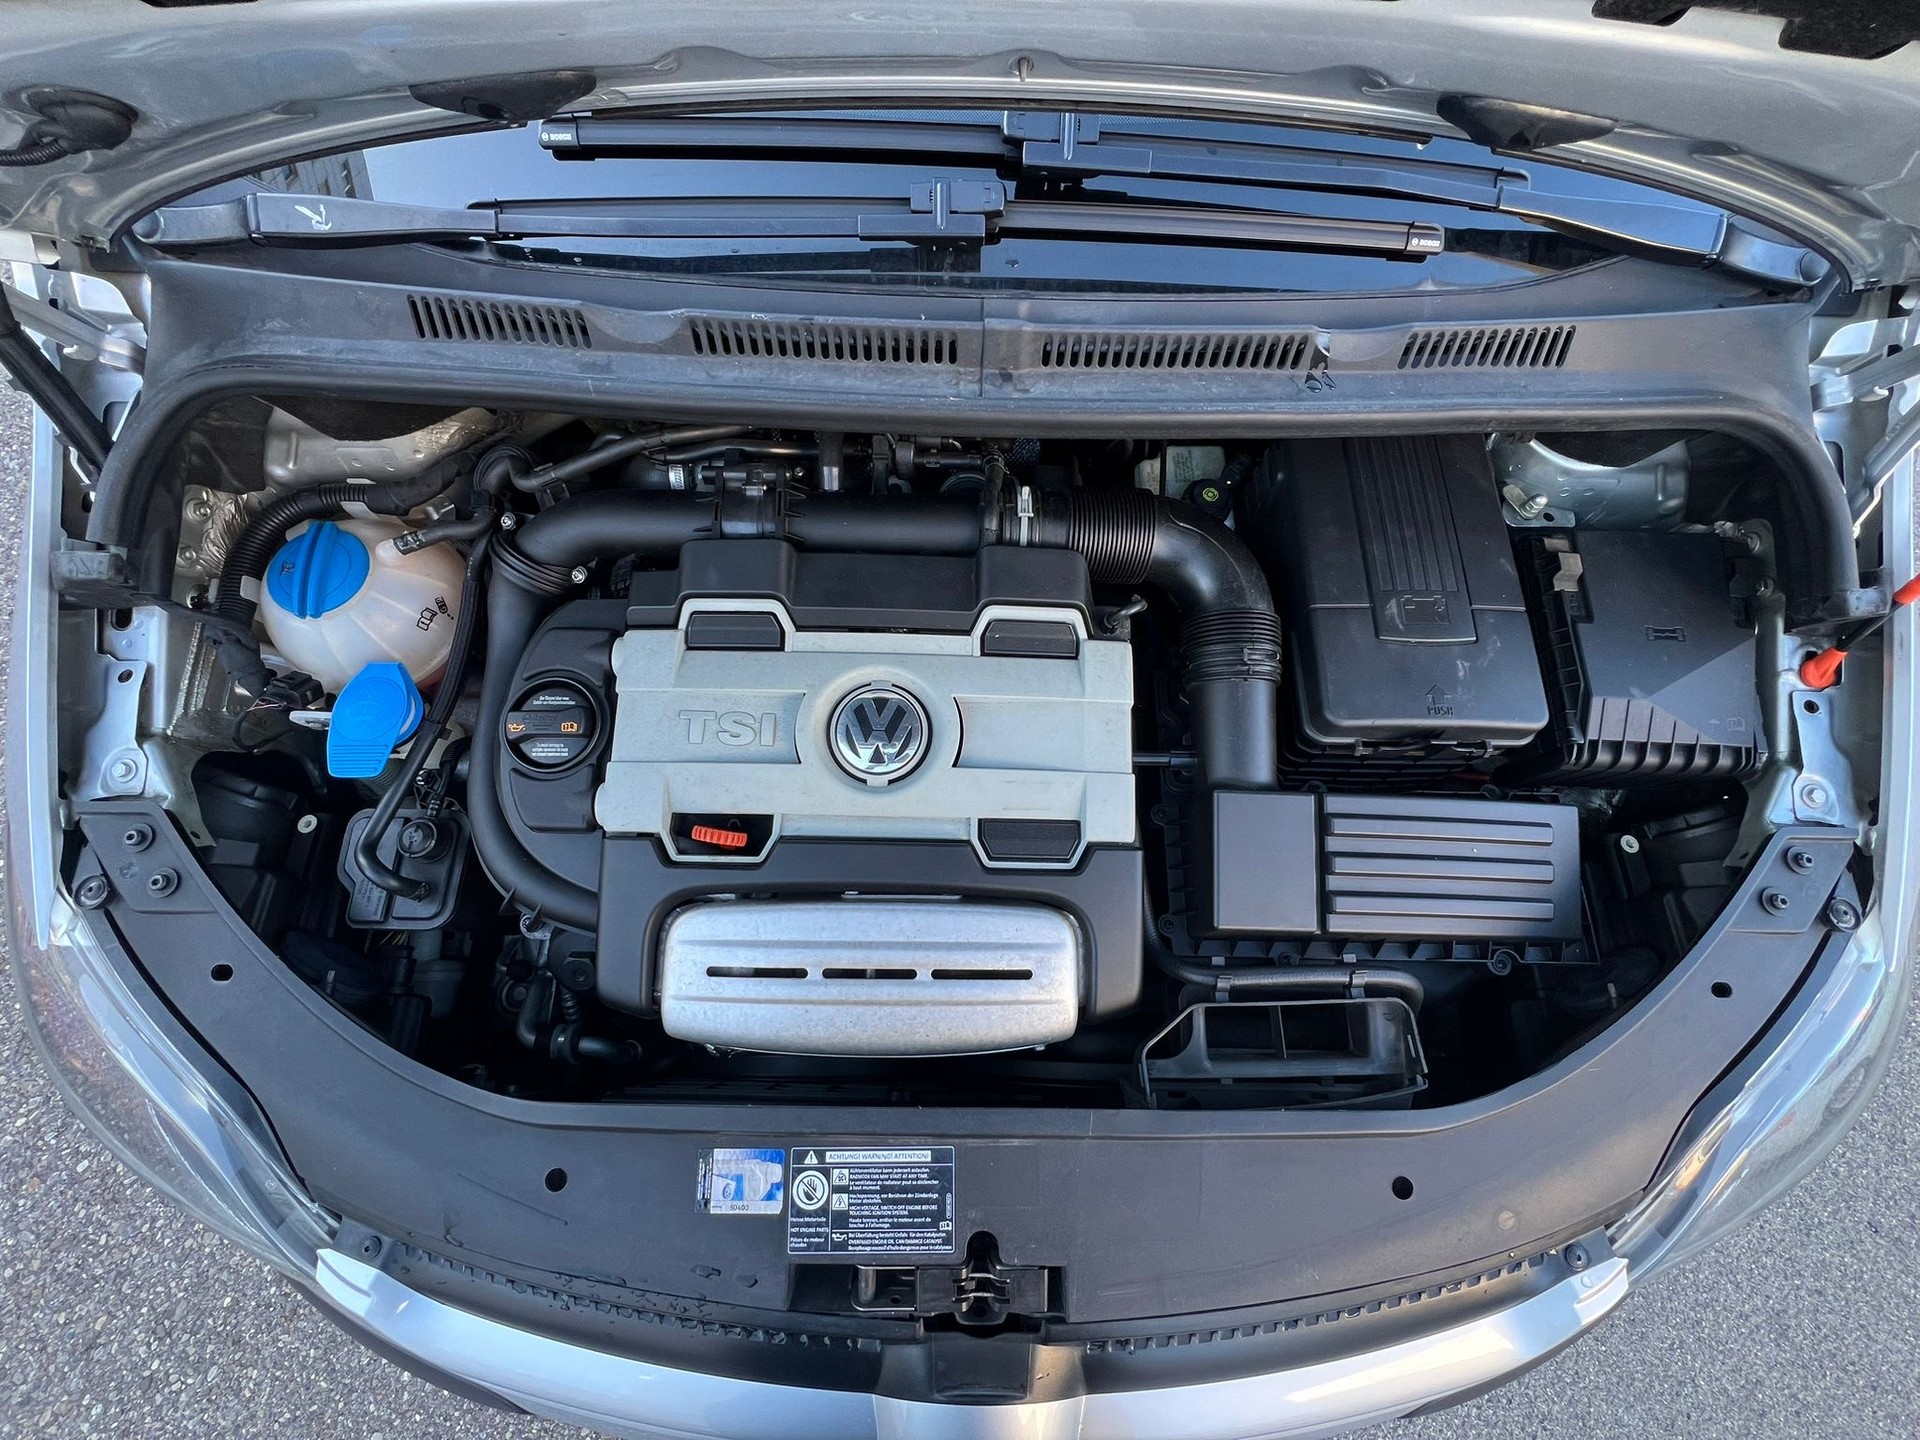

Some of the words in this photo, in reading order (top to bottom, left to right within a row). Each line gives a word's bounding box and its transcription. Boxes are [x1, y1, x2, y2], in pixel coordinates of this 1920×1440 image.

[1427, 705, 1453, 717] PUSH
[678, 709, 777, 747] TSI
[829, 1153, 860, 1161] ACHTUNG!
[893, 1152, 929, 1160] ATTENTION!
